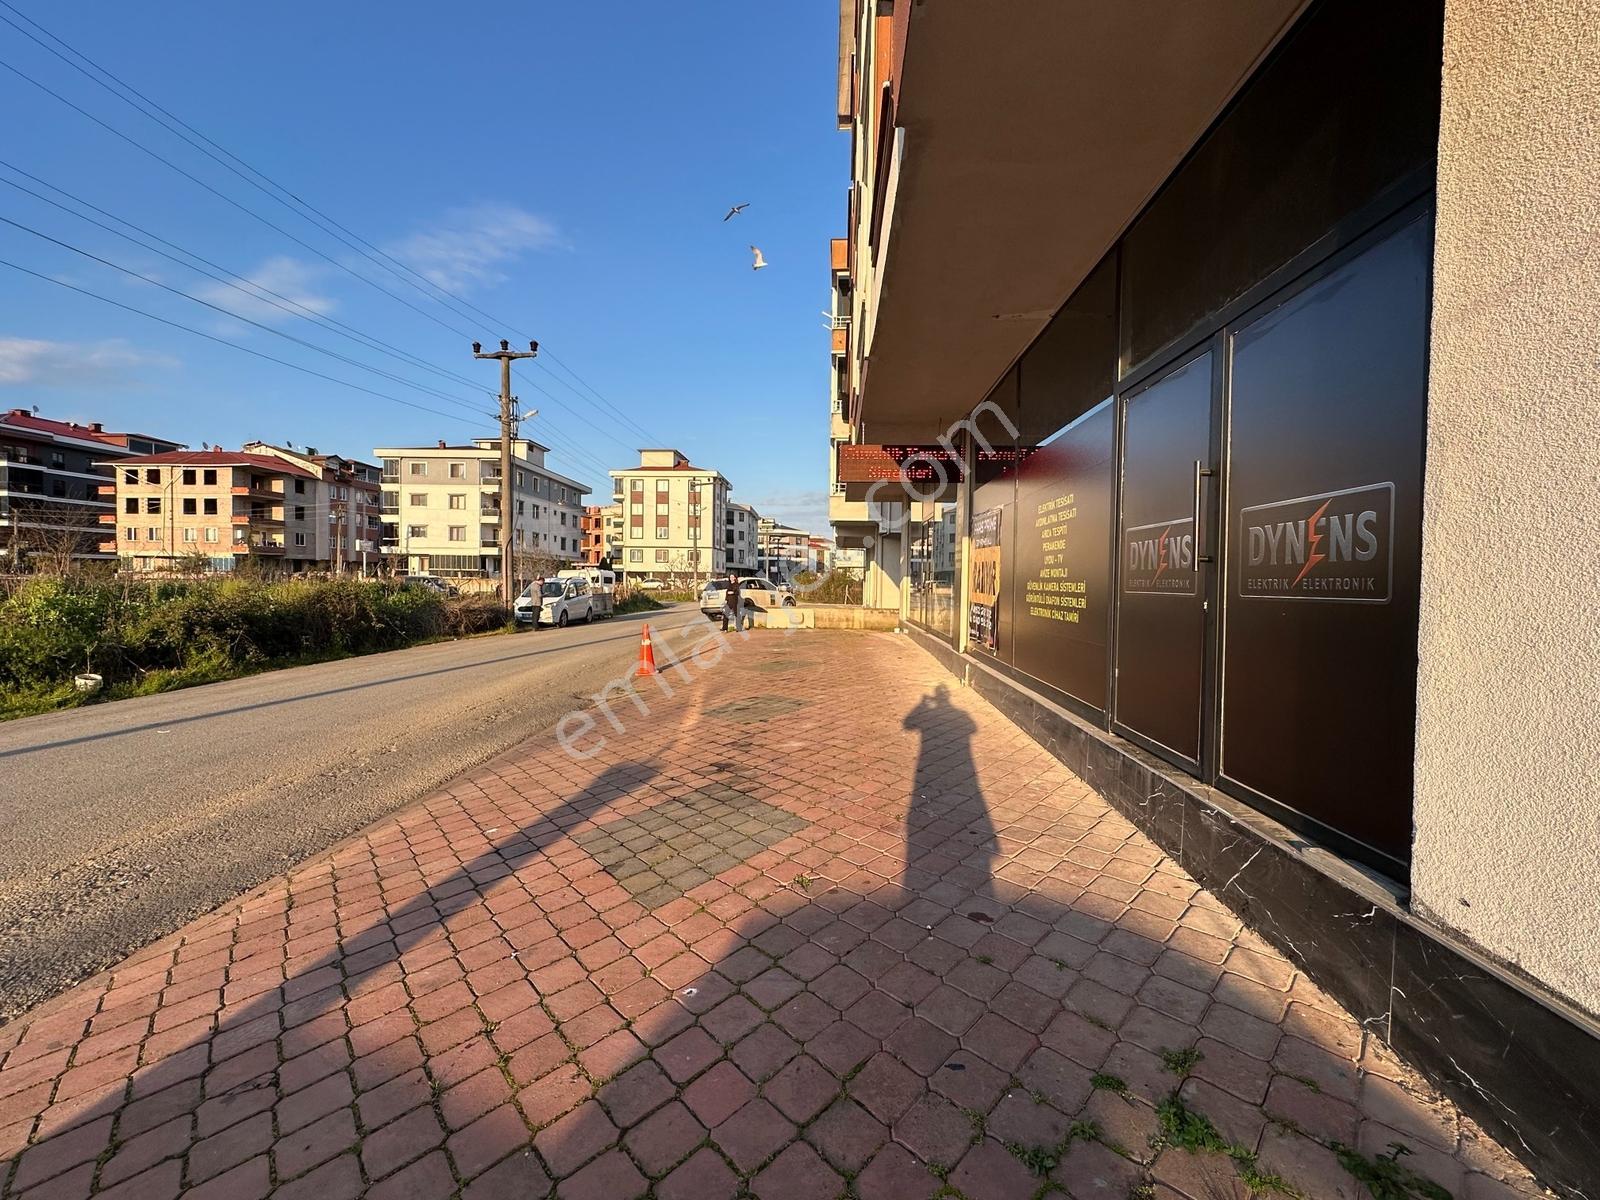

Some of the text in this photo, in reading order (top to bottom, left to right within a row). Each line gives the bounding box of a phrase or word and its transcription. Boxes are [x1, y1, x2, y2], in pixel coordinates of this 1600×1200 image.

[1248, 510, 1378, 567] DYNENS
[1247, 577, 1375, 591] ELEKTRIK ELEKTRONIK
